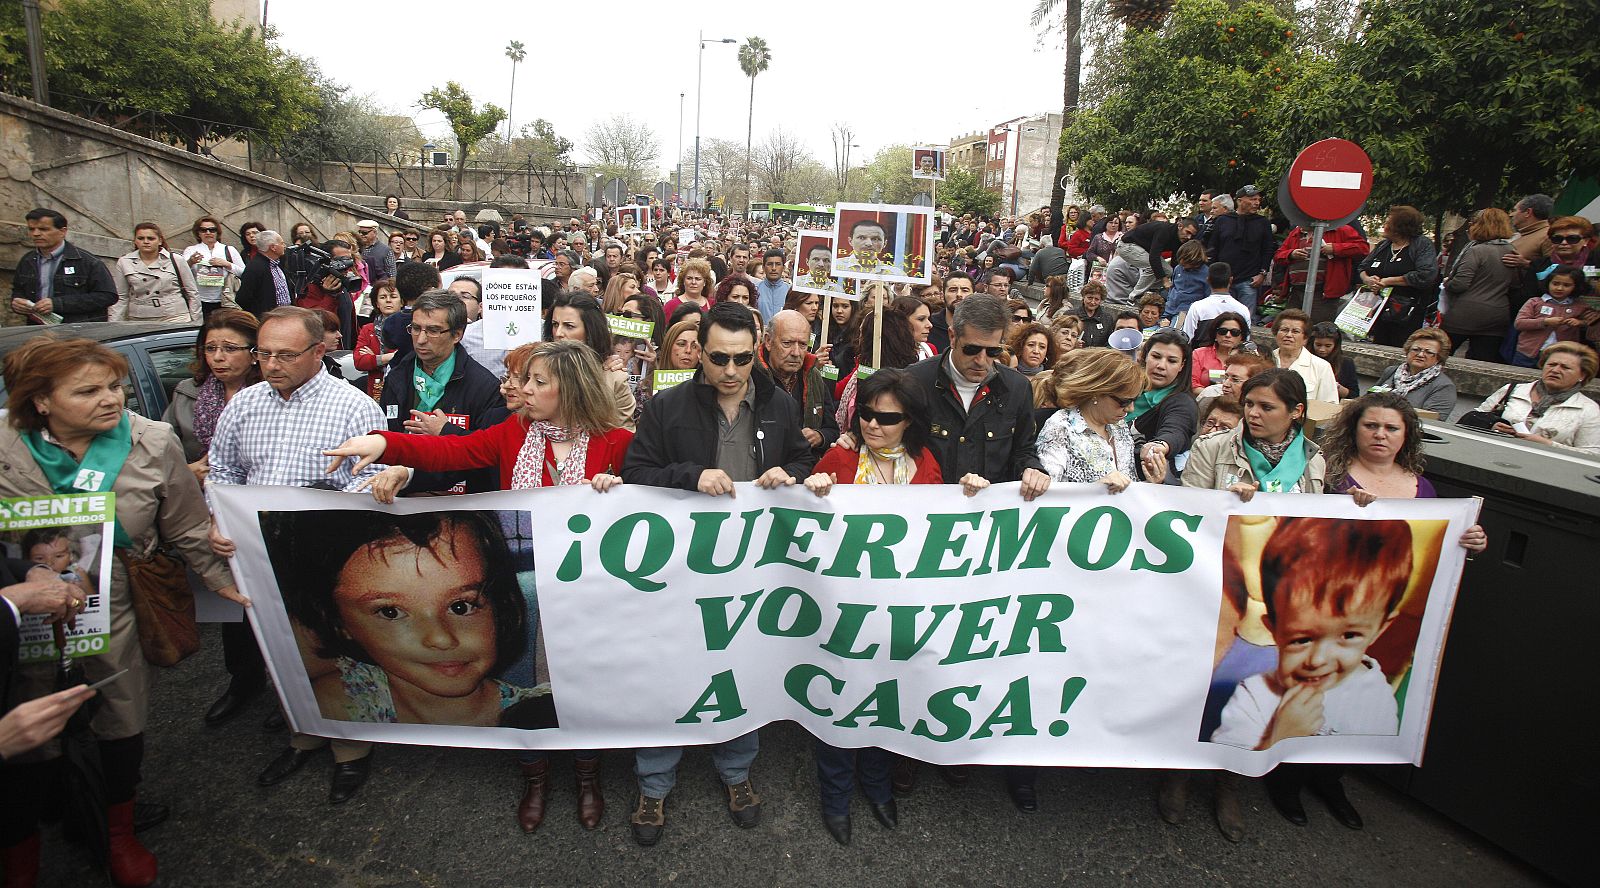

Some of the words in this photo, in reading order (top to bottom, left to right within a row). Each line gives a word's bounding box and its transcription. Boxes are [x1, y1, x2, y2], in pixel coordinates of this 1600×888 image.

[838, 249, 894, 259] BASTA
[904, 253, 924, 261] YA
[798, 268, 829, 277] BAST
[485, 282, 512, 291] ¿DÓNDE
[515, 283, 538, 291] ESTÁN
[486, 293, 499, 301] LOS
[500, 293, 537, 302] PEQUEÑOS
[488, 304, 507, 312] RUTH
[9, 514, 106, 528] DESAPARECIDOS
[556, 506, 1203, 592] ¡QUEREMOS
[695, 587, 1075, 666] VOLVER
[63, 637, 104, 655] 500
[675, 669, 748, 724] A
[783, 664, 1087, 743] CASA!
